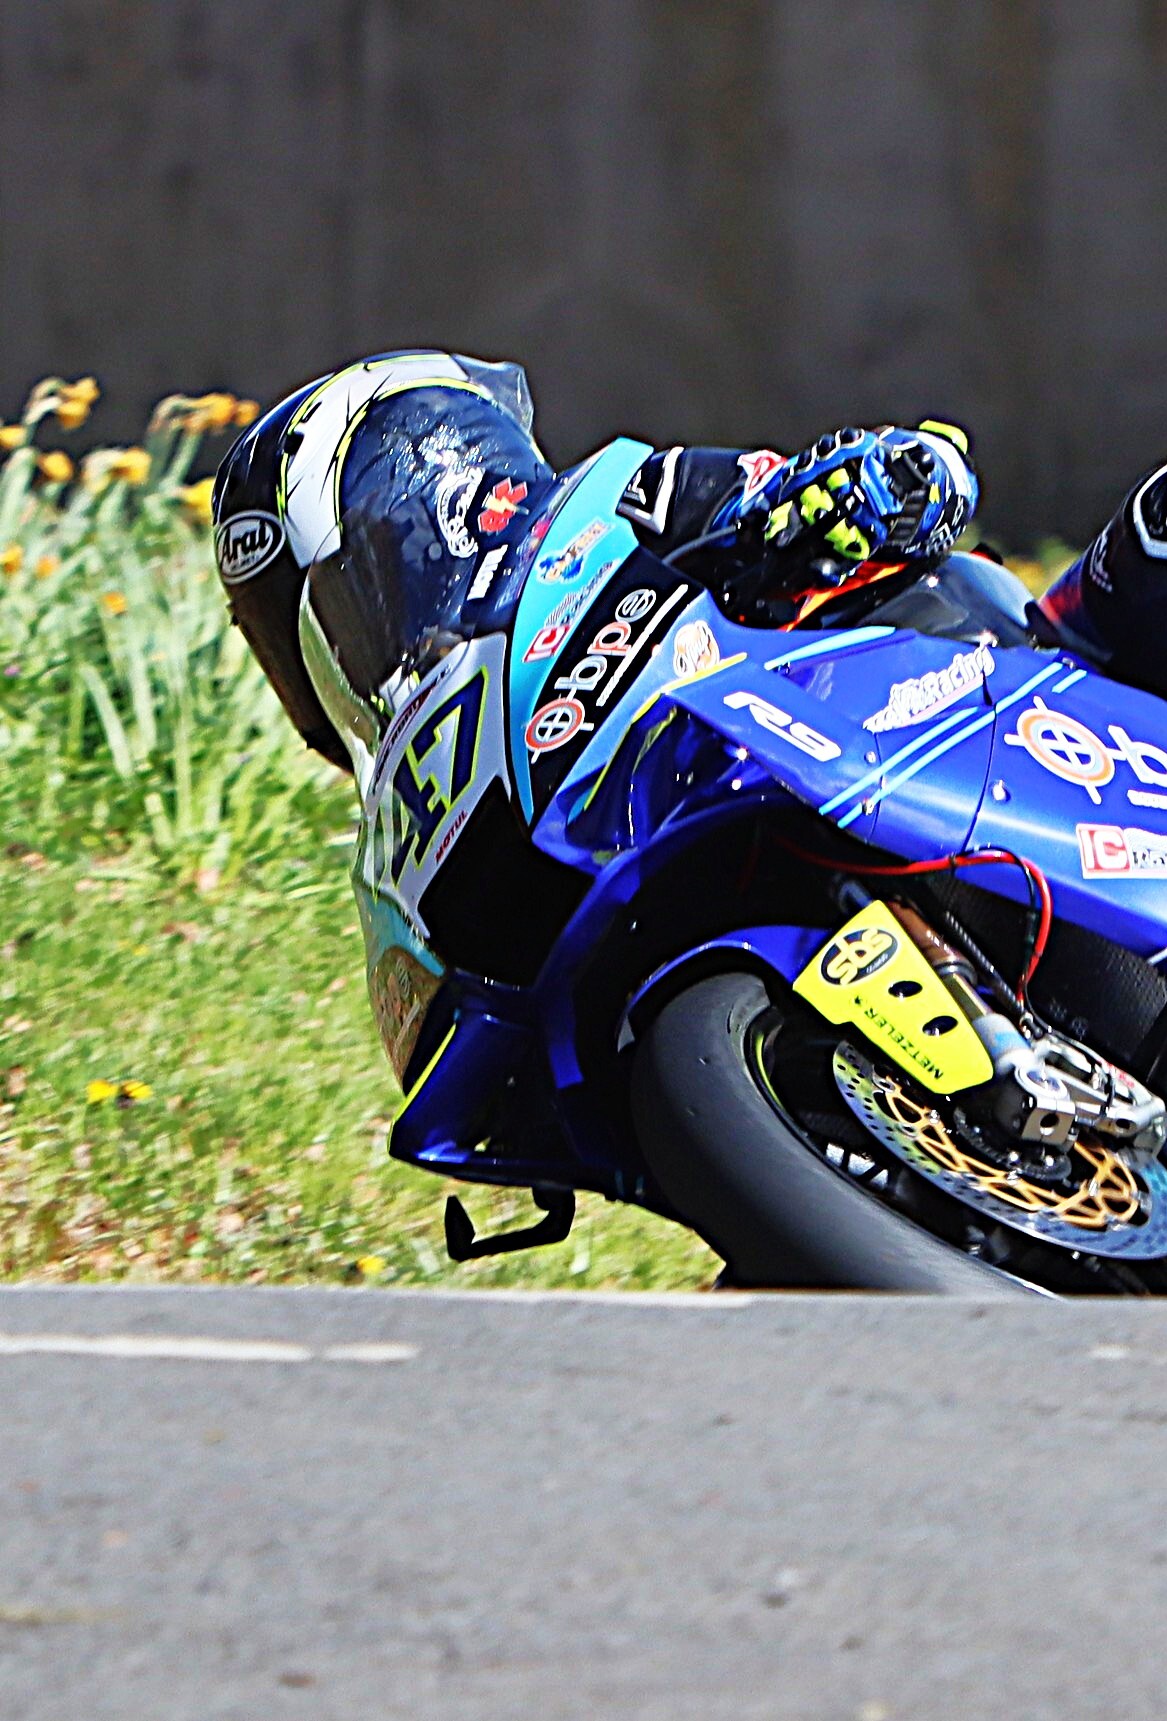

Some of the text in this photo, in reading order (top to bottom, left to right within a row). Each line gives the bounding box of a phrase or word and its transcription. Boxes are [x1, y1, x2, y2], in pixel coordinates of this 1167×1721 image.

[222, 520, 272, 565] Arai
[434, 809, 469, 864] MOTUL
[863, 1007, 944, 1080] METZELER
